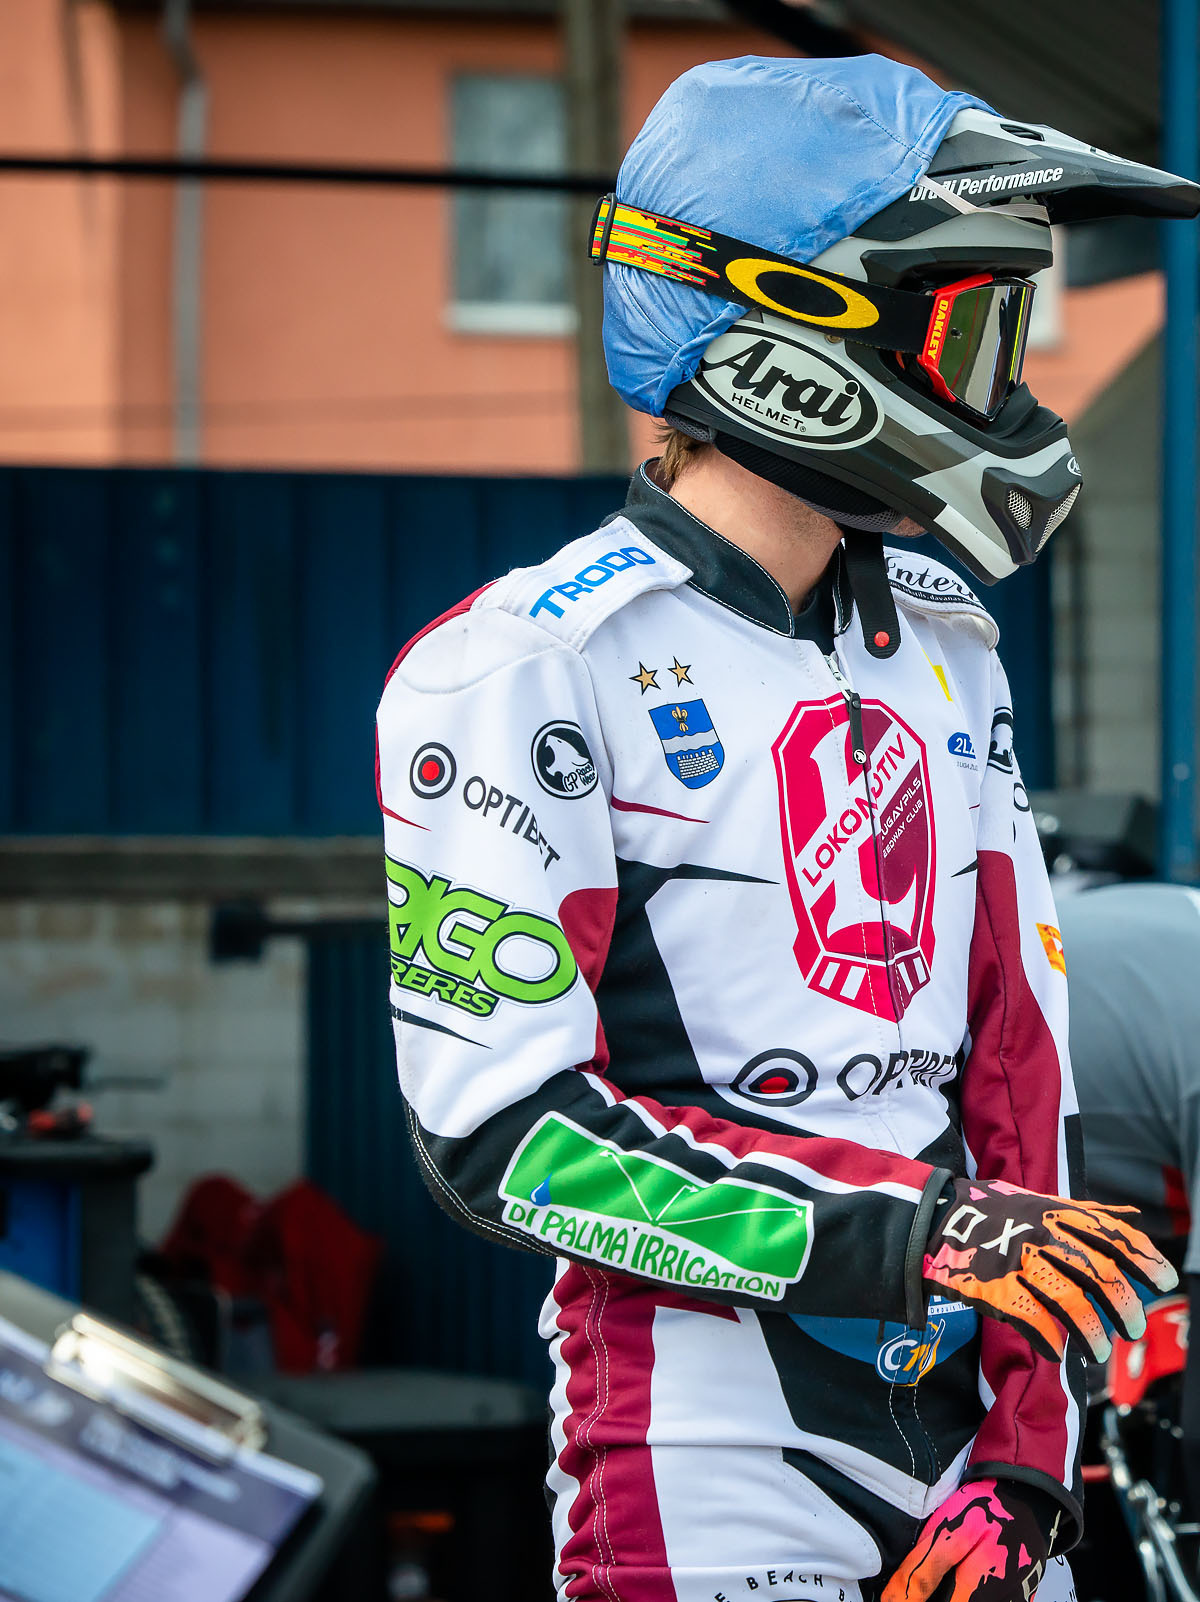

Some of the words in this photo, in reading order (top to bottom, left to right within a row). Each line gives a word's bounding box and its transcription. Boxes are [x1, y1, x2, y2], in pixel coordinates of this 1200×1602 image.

[957, 167, 1064, 196] Performance
[927, 299, 949, 360] OAKLEY
[702, 338, 860, 427] Arai
[731, 391, 804, 430] HELMET
[528, 546, 657, 619] TRODO
[881, 776, 922, 840] UGAVPILS
[905, 799, 924, 824] CLUB
[507, 1203, 539, 1228] DI
[539, 1210, 630, 1265] PALMA
[630, 1233, 781, 1298] IRRIGATION
[941, 1203, 1035, 1257] OX
